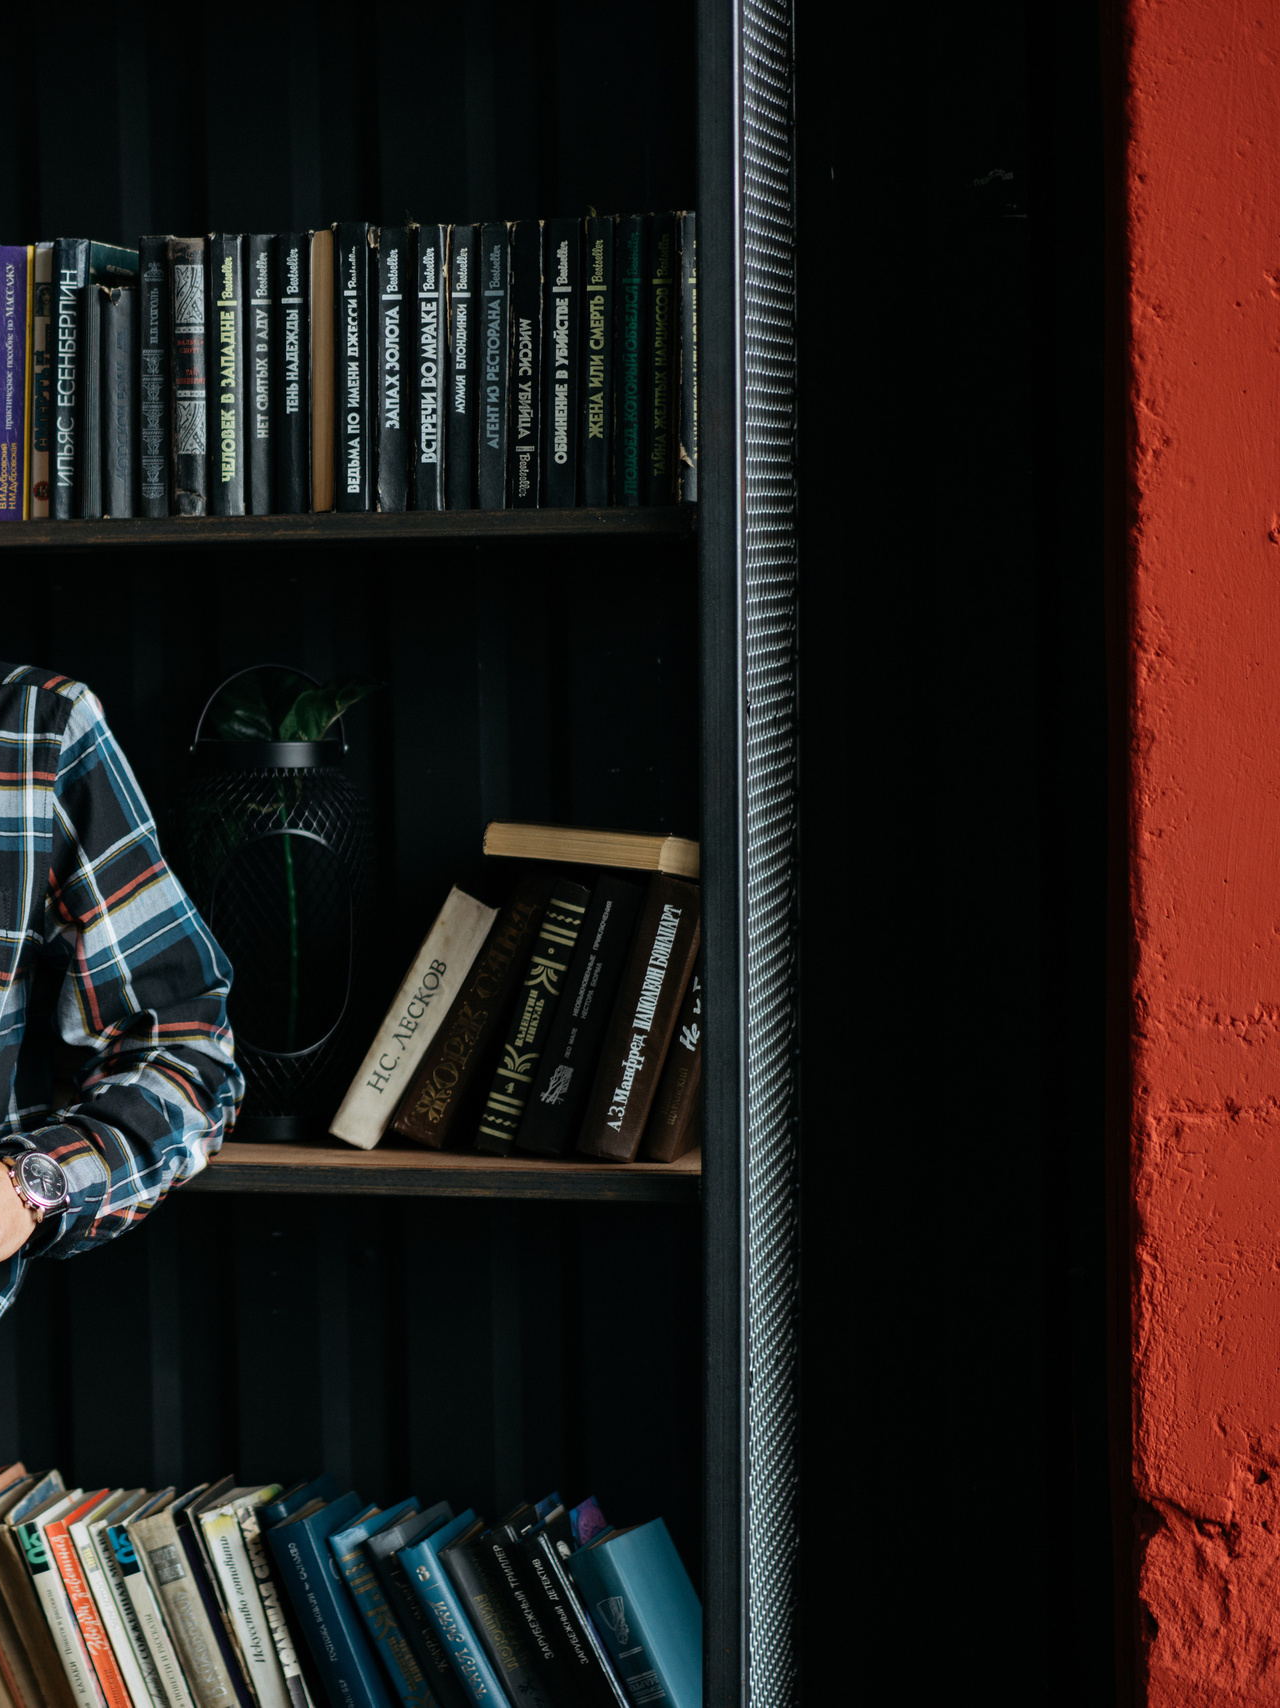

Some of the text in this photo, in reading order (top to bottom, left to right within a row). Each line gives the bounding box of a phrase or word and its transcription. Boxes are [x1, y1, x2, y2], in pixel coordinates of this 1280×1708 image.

[4, 262, 14, 430] практическое пособие по МАССАЖУ
[57, 270, 77, 486] ИЛЬЯС ЕСЕНБЕРЛИН
[220, 256, 237, 482] ЧЕЛОВЕК В ЗАПАДНЕ Bestseller
[256, 252, 270, 438] НЕТ СВЯТЫХ В АДУ Bestseller
[286, 248, 301, 414] ТЕНЬ НАДЕЖДЫ Bestseller
[347, 298, 360, 357] ДЖЕССИ
[348, 362, 360, 407] ИМЕНИ
[385, 249, 400, 429] ЗАПАХ ЗОЛОТА Bestseller
[421, 247, 437, 463] ВСТРЕЧИ ВО МРАКЕ Bestseller
[455, 247, 468, 414] МУМИЯ БЛОНДИНКИ Bestseller
[487, 244, 502, 449] АГЕНТ ИЗ РЕСТОРАНА Bestseller
[553, 240, 569, 464] ОБВИНЕНИЕ В УБИЙСТВЕ Bestseller
[589, 239, 604, 439] ЖЕНА ИЛИ СМЕРТЬ Bestseller
[622, 231, 639, 495] ЛЮДОЕД, КОТОРЫЙ ОБЪЕЛСЯ Bestseller
[654, 233, 670, 476] ТАЙНА ЖЕЛТЫХ НАРЦИССОВ Bestseller
[35, 368, 50, 452] СМЕРТЬ
[347, 438, 361, 494] ВЕДЬМА
[348, 413, 360, 434] ПО
[518, 318, 532, 498] МИССИС УБИЙЦА Bestseller
[392, 959, 447, 1051] ЛЕСКОВ
[418, 901, 542, 1123] ЖОРЖ САНД
[514, 989, 538, 1047] ВАЛЕНТИН
[571, 899, 613, 1017] НЕОБЫКНОВЕННЫЕ ПРИКЛЮЧЕНИЯ
[579, 989, 594, 1019] НЕСТОРА
[632, 969, 664, 1032] НАПОЛЕОН
[657, 904, 682, 971] БОНАПАРТ
[525, 998, 544, 1044] ПИКУЛЬ
[563, 1027, 578, 1058] ЛЕО МАЛЕ
[504, 1081, 515, 1093] 4
[45, 1588, 61, 1620] рассказы
[49, 1531, 109, 1655] Звезда заветная
[57, 1626, 72, 1655] Повести
[98, 1529, 150, 1660] СОЖЖЕННАЯ МОСКВА
[144, 1611, 166, 1654] РАССКАЗЫ
[217, 1534, 266, 1664] Искусство готовить
[238, 1513, 301, 1677] БОЛЬШАЯ СКУКА
[287, 1541, 338, 1662] ГОСПОЖА БОВАРИ САЛАМБО
[428, 1591, 489, 1701] КАРЛ МАЙ
[472, 1591, 519, 1673] ПОЮЩИЕ
[491, 1541, 555, 1661] ЗАРУБЕЖНЫЙ ТРИЛЛЕР
[530, 1556, 590, 1666] ЗАРУБЕЖНЫЙ ДЕТЕКТИВ
[68, 1660, 86, 1694] КАЗАКИ
[163, 1661, 184, 1702] ПОВЕСТИ
